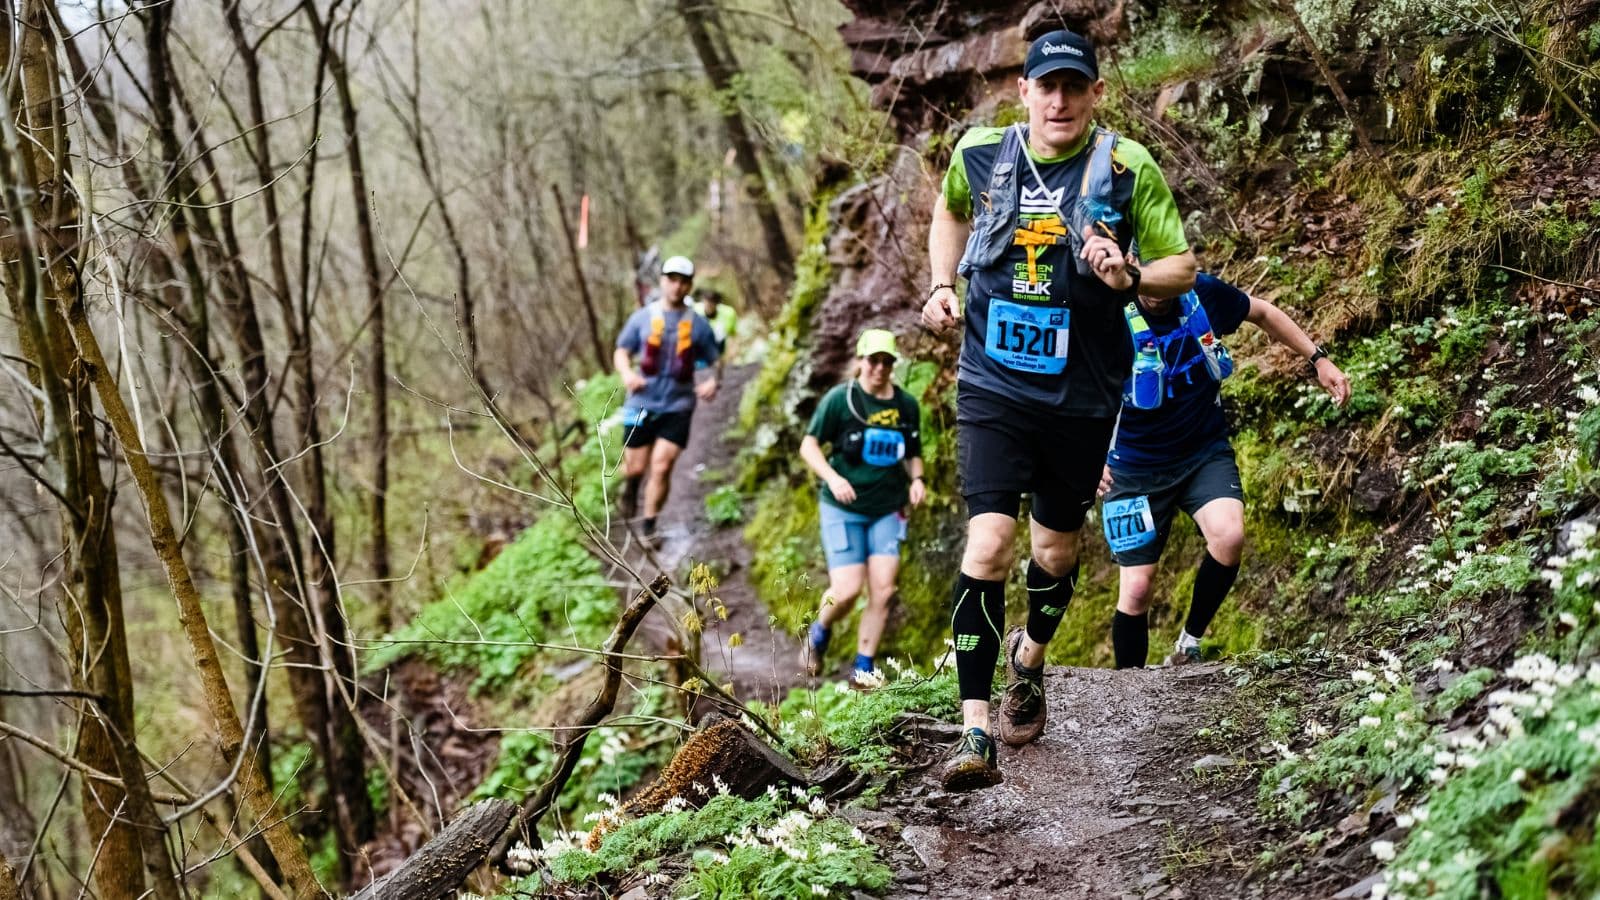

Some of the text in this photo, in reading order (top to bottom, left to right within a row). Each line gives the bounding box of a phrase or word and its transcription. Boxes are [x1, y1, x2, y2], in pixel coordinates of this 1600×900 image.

[1014, 262, 1054, 273] GREN
[1013, 271, 1052, 282] JEEL
[1012, 279, 1053, 296] 50K
[996, 320, 1058, 357] 1520
[1107, 512, 1146, 540] 1770
